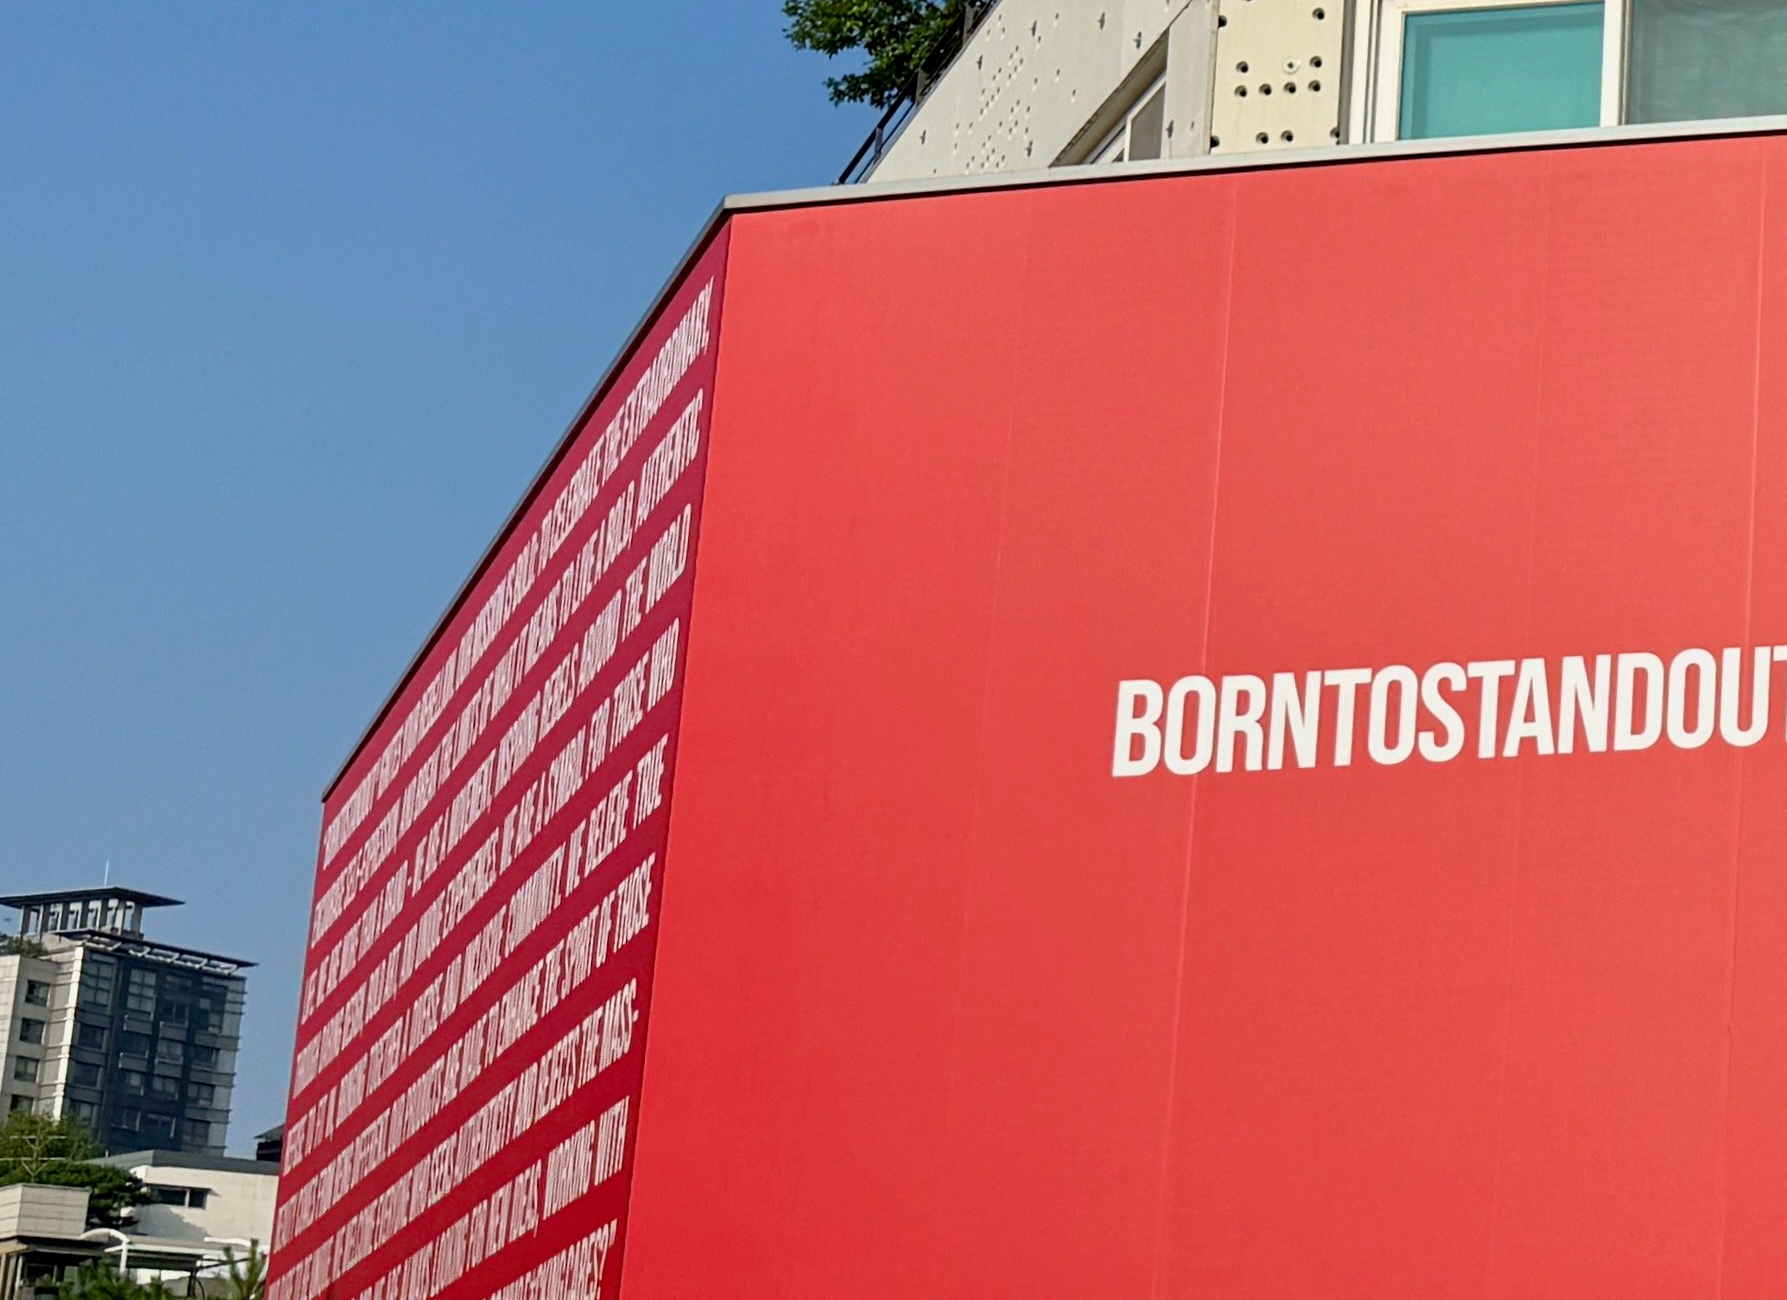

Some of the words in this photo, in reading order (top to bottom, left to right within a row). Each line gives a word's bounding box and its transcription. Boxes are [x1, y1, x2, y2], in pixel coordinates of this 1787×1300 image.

[634, 386, 703, 529] AUTHENTIC
[619, 559, 646, 644] THE
[644, 502, 691, 614] WORLD
[585, 698, 610, 779] FOR
[607, 654, 648, 754] THOSE
[646, 618, 679, 711] WHO
[583, 772, 632, 877] BELIEVE
[631, 735, 667, 829] TRUE
[540, 941, 563, 1016] THE
[612, 854, 654, 952] THOSE
[576, 1008, 602, 1087] THE
[598, 974, 642, 1070] MASS-
[541, 1123, 595, 1220] WORKING
[593, 1098, 629, 1185] WITH
